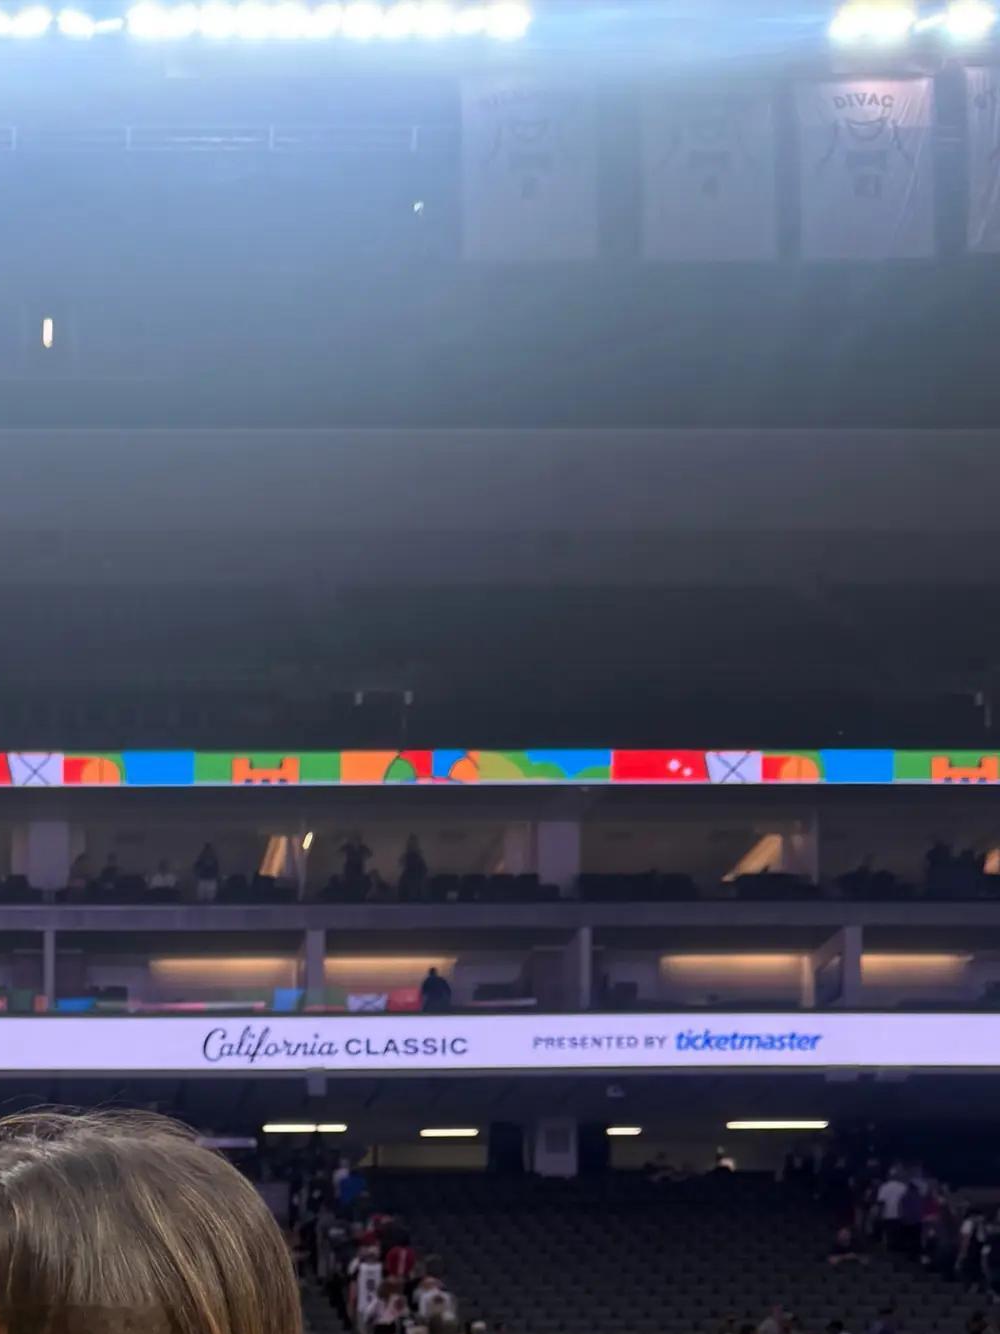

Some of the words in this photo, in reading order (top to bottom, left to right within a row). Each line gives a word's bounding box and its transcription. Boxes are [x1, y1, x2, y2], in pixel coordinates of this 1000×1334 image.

[833, 91, 894, 110] DIVAC
[202, 1025, 338, 1063] California
[344, 1037, 469, 1055] CLASSIC
[532, 1035, 639, 1050] PRESENTED
[643, 1036, 667, 1050] BY
[675, 1028, 822, 1052] ticketmaster
